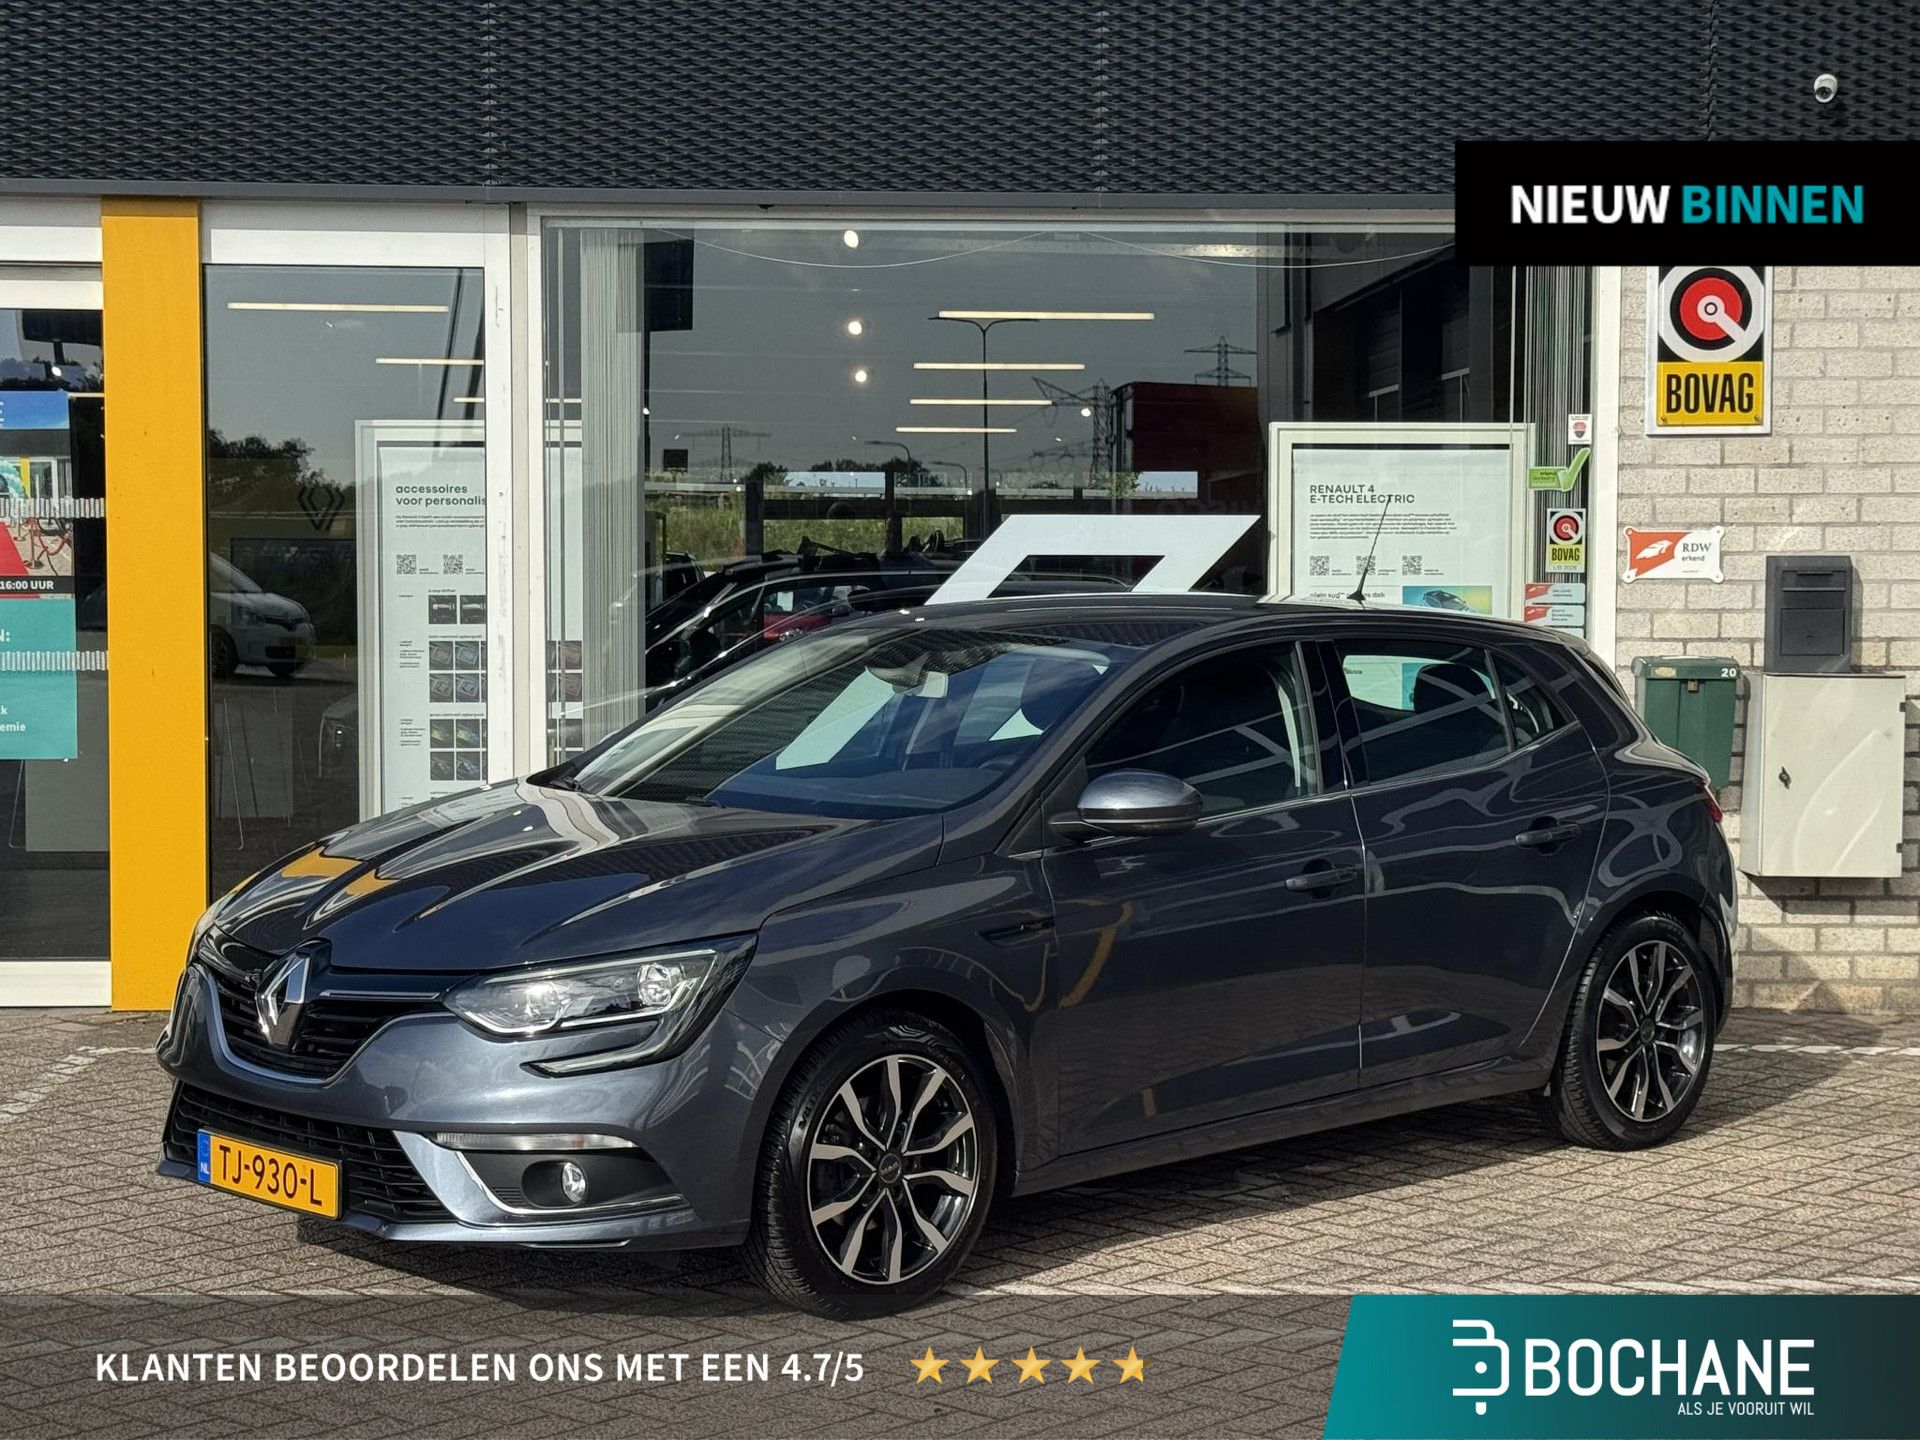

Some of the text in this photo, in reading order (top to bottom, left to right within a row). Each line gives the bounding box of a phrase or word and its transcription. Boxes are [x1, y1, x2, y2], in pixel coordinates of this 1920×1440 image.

[1666, 373, 1754, 413] BOVAG
[395, 484, 468, 494] accessoires
[1309, 484, 1375, 494] RENAULT 4
[395, 497, 423, 506] voor
[1309, 494, 1415, 504] E-TECH ELECTRIC
[1682, 542, 1712, 553] RDW
[1551, 547, 1580, 562] BOVAG
[30, 580, 54, 590] UUR
[1720, 667, 1737, 678] 20
[200, 1161, 210, 1175] NL
[218, 1144, 323, 1207] TJ-930-L
